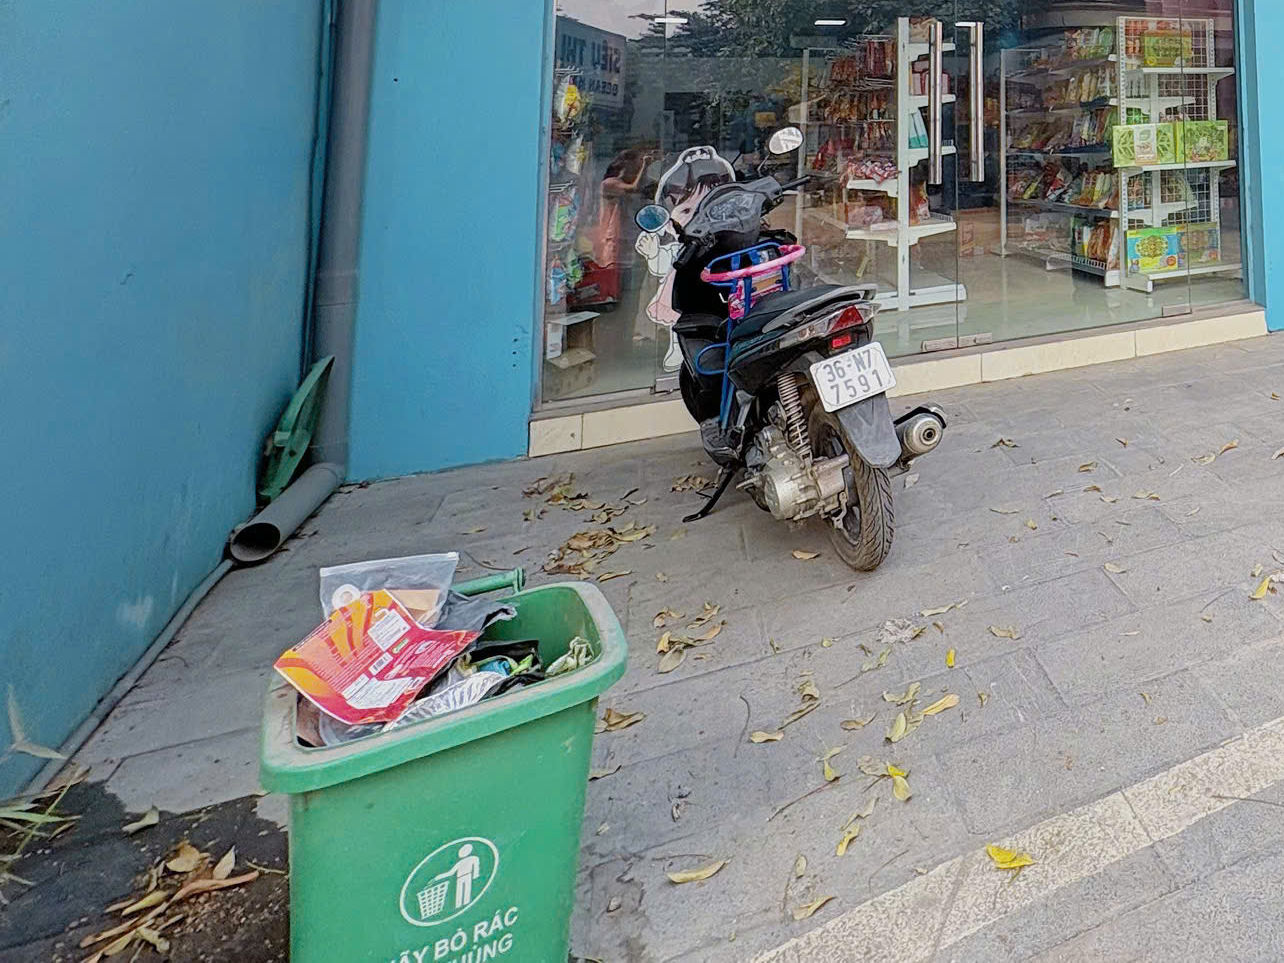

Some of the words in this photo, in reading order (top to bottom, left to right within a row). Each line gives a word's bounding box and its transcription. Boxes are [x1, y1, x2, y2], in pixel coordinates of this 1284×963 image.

[823, 349, 872, 383] 36-N7
[830, 369, 883, 404] 7591
[434, 928, 467, 960] BỎ
[473, 906, 519, 943] RÁC
